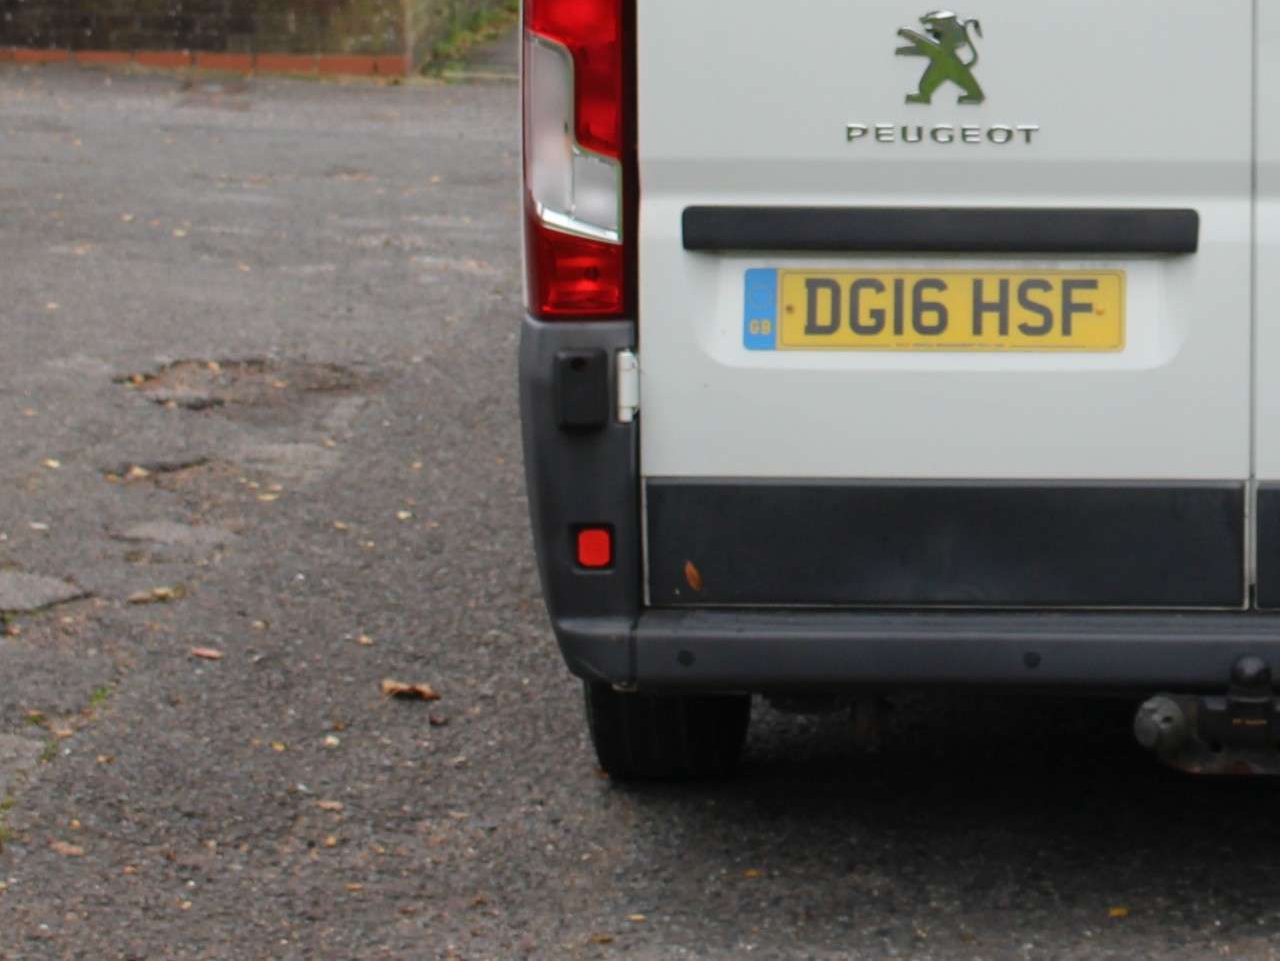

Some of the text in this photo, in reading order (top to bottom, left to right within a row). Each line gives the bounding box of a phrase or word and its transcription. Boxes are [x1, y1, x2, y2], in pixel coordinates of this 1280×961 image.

[846, 123, 1040, 145] PEUGEOT
[803, 277, 1100, 337] DG16 HSF
